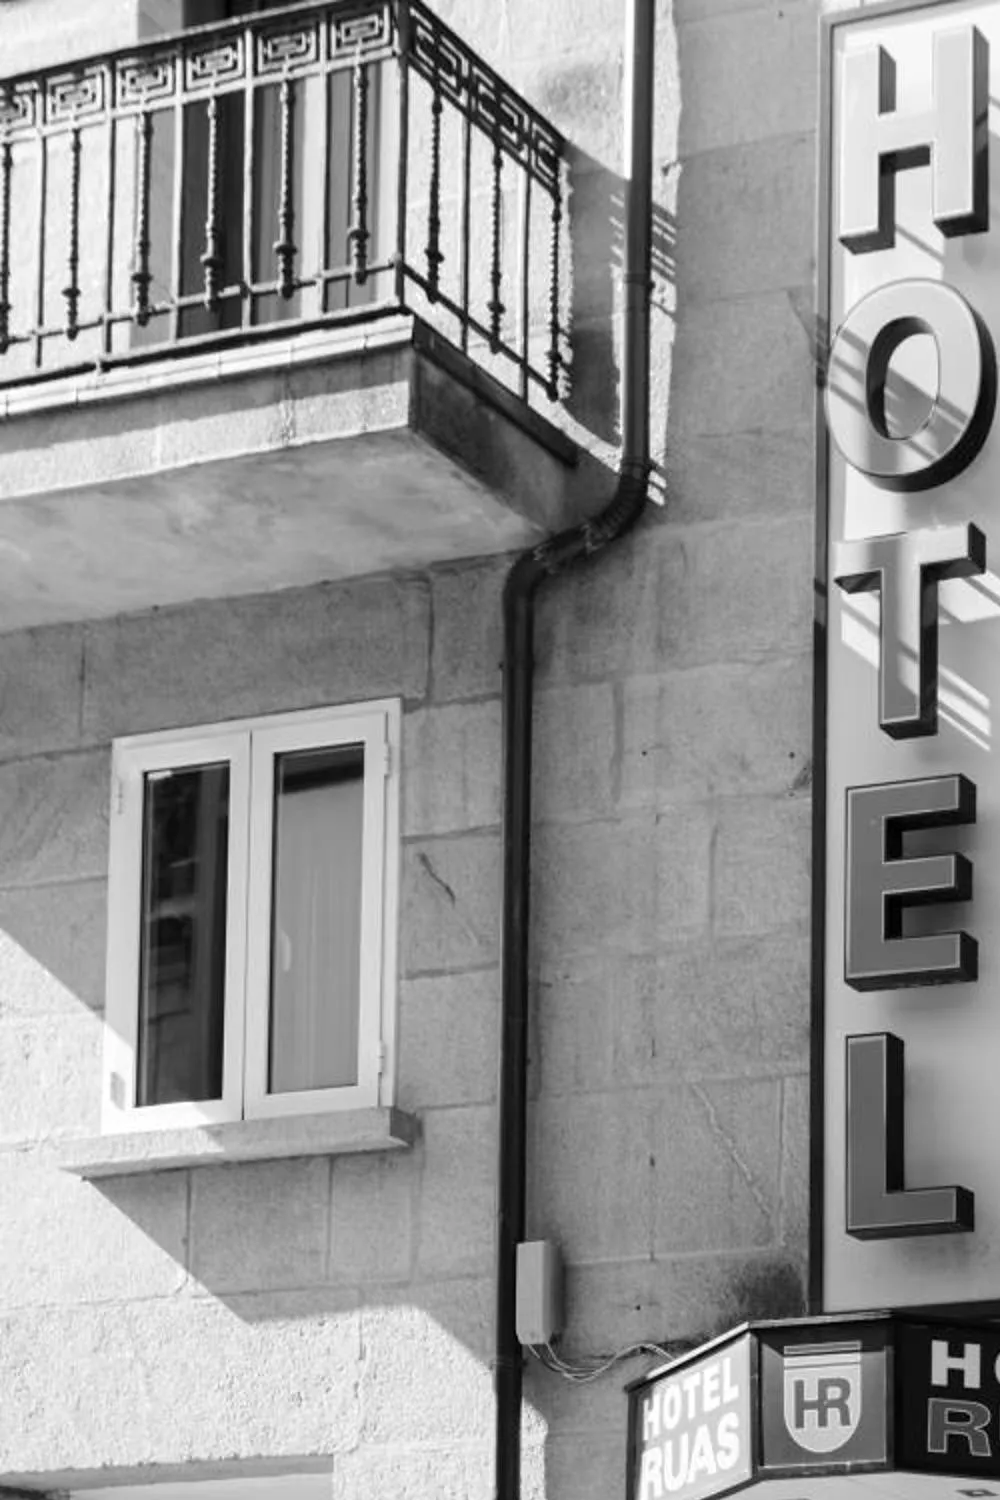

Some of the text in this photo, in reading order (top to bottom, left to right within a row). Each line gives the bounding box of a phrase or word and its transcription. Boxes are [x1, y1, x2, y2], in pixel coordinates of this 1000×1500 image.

[824, 24, 998, 1242] HOTEL
[642, 1356, 740, 1442] HOTEL
[793, 1376, 852, 1430] HR
